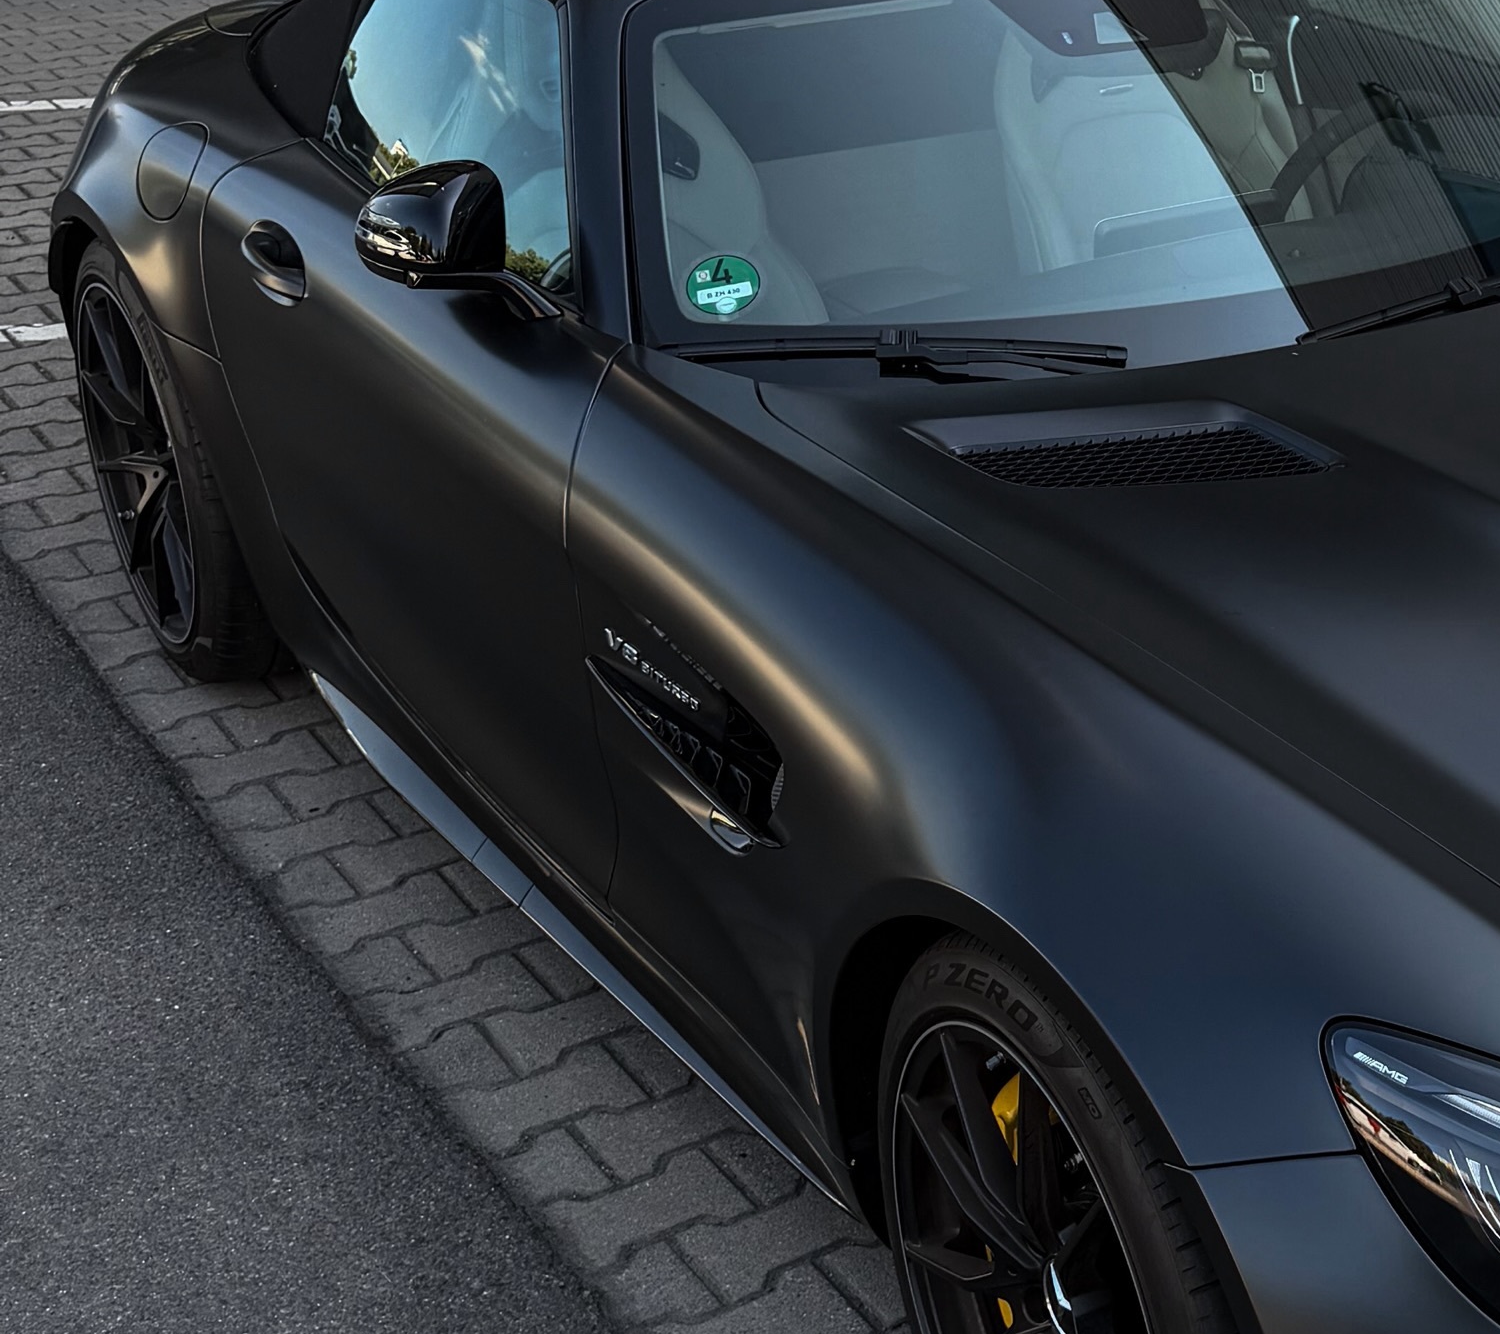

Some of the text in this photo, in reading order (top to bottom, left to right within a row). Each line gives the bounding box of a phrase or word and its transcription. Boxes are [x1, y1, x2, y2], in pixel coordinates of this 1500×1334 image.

[711, 258, 733, 284] 4
[604, 628, 700, 711] V8 BITURBO
[943, 962, 1038, 1032] ZERO
